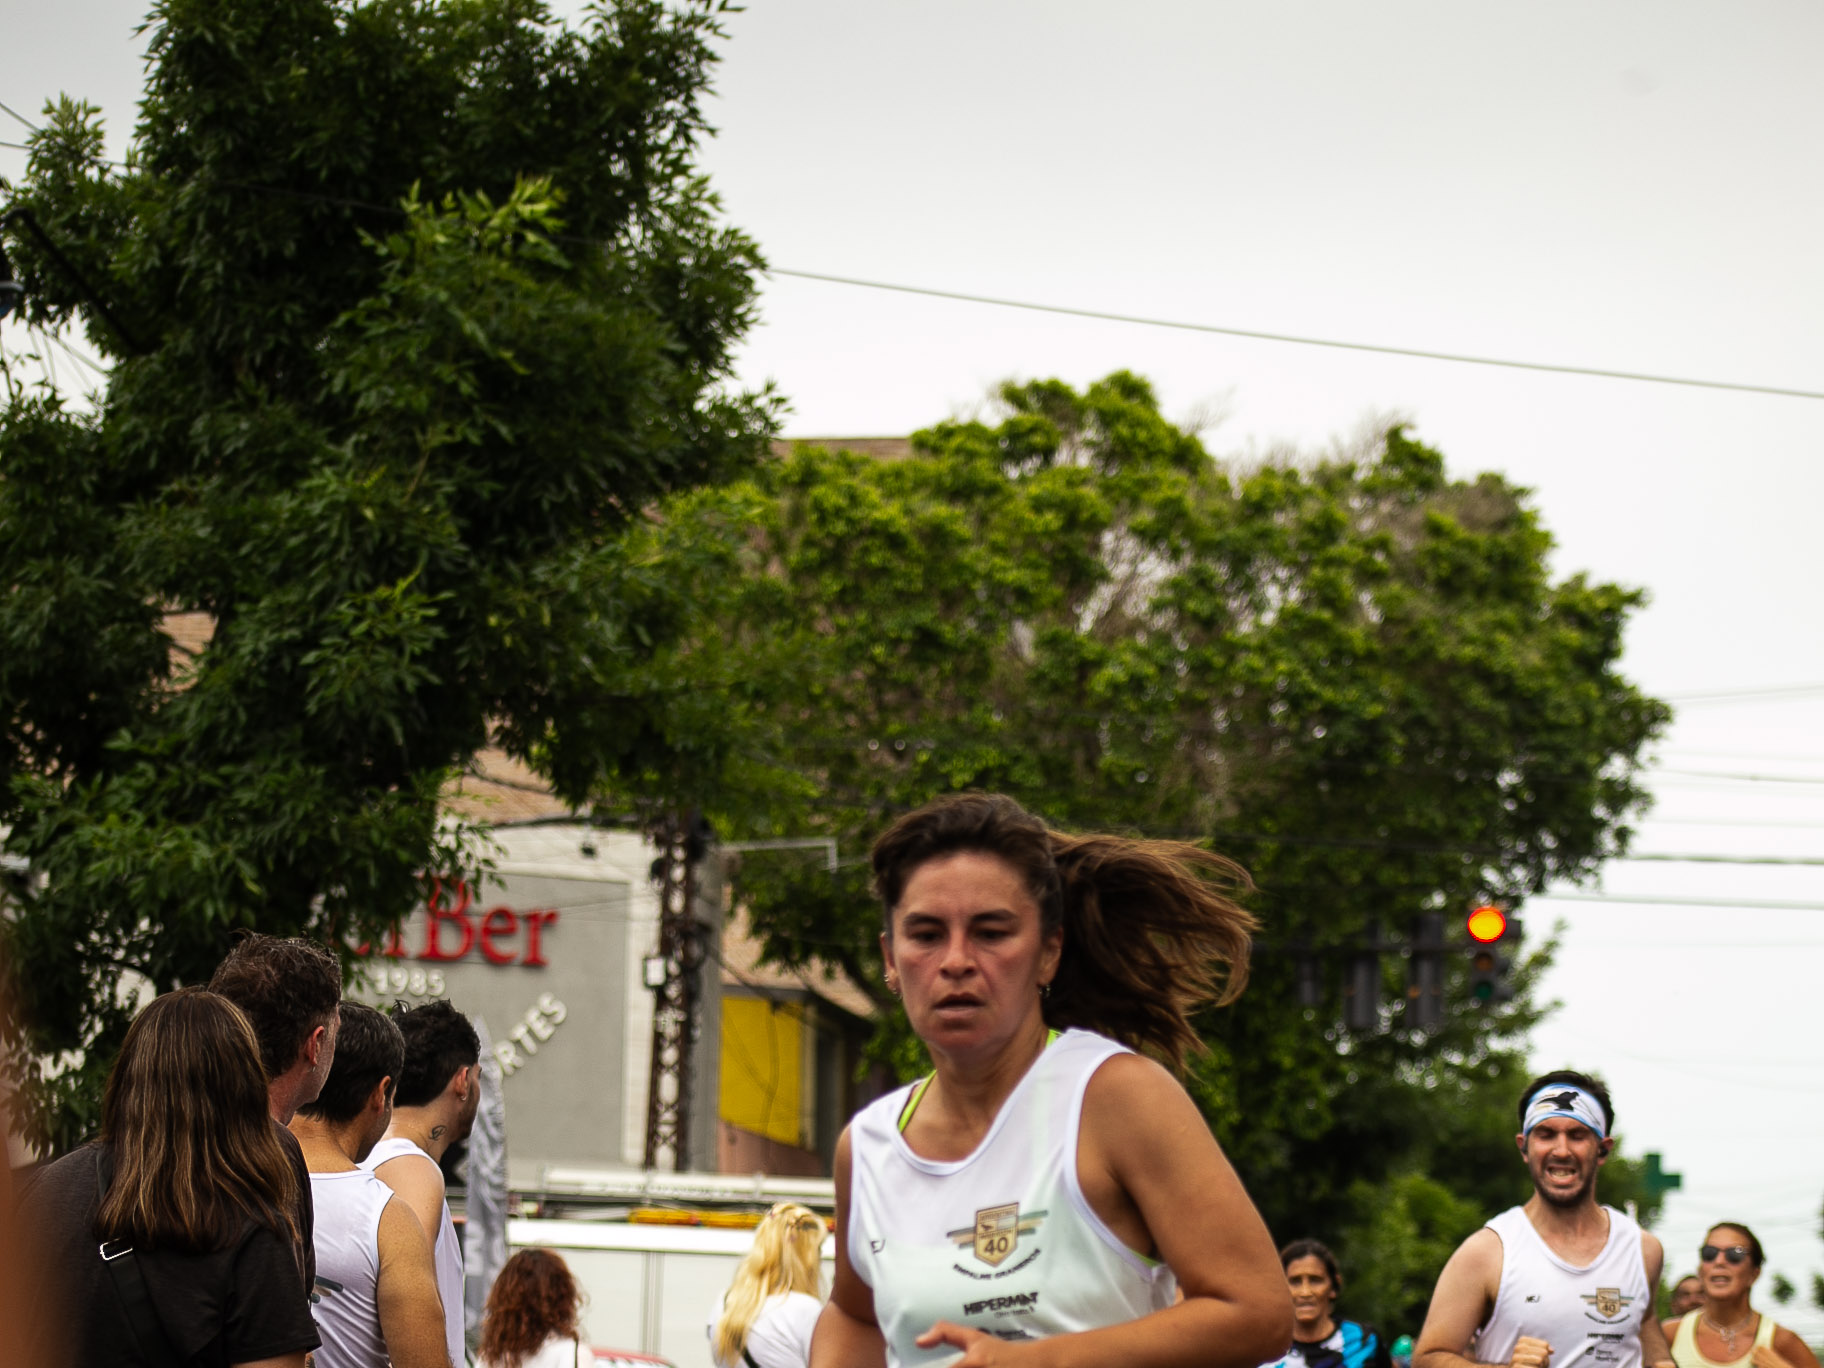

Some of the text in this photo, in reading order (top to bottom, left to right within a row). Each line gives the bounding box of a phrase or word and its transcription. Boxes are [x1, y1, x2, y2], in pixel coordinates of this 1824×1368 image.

[492, 992, 567, 1077] RTES
[984, 1236, 1009, 1255] 40
[1602, 1303, 1616, 1313] 40
